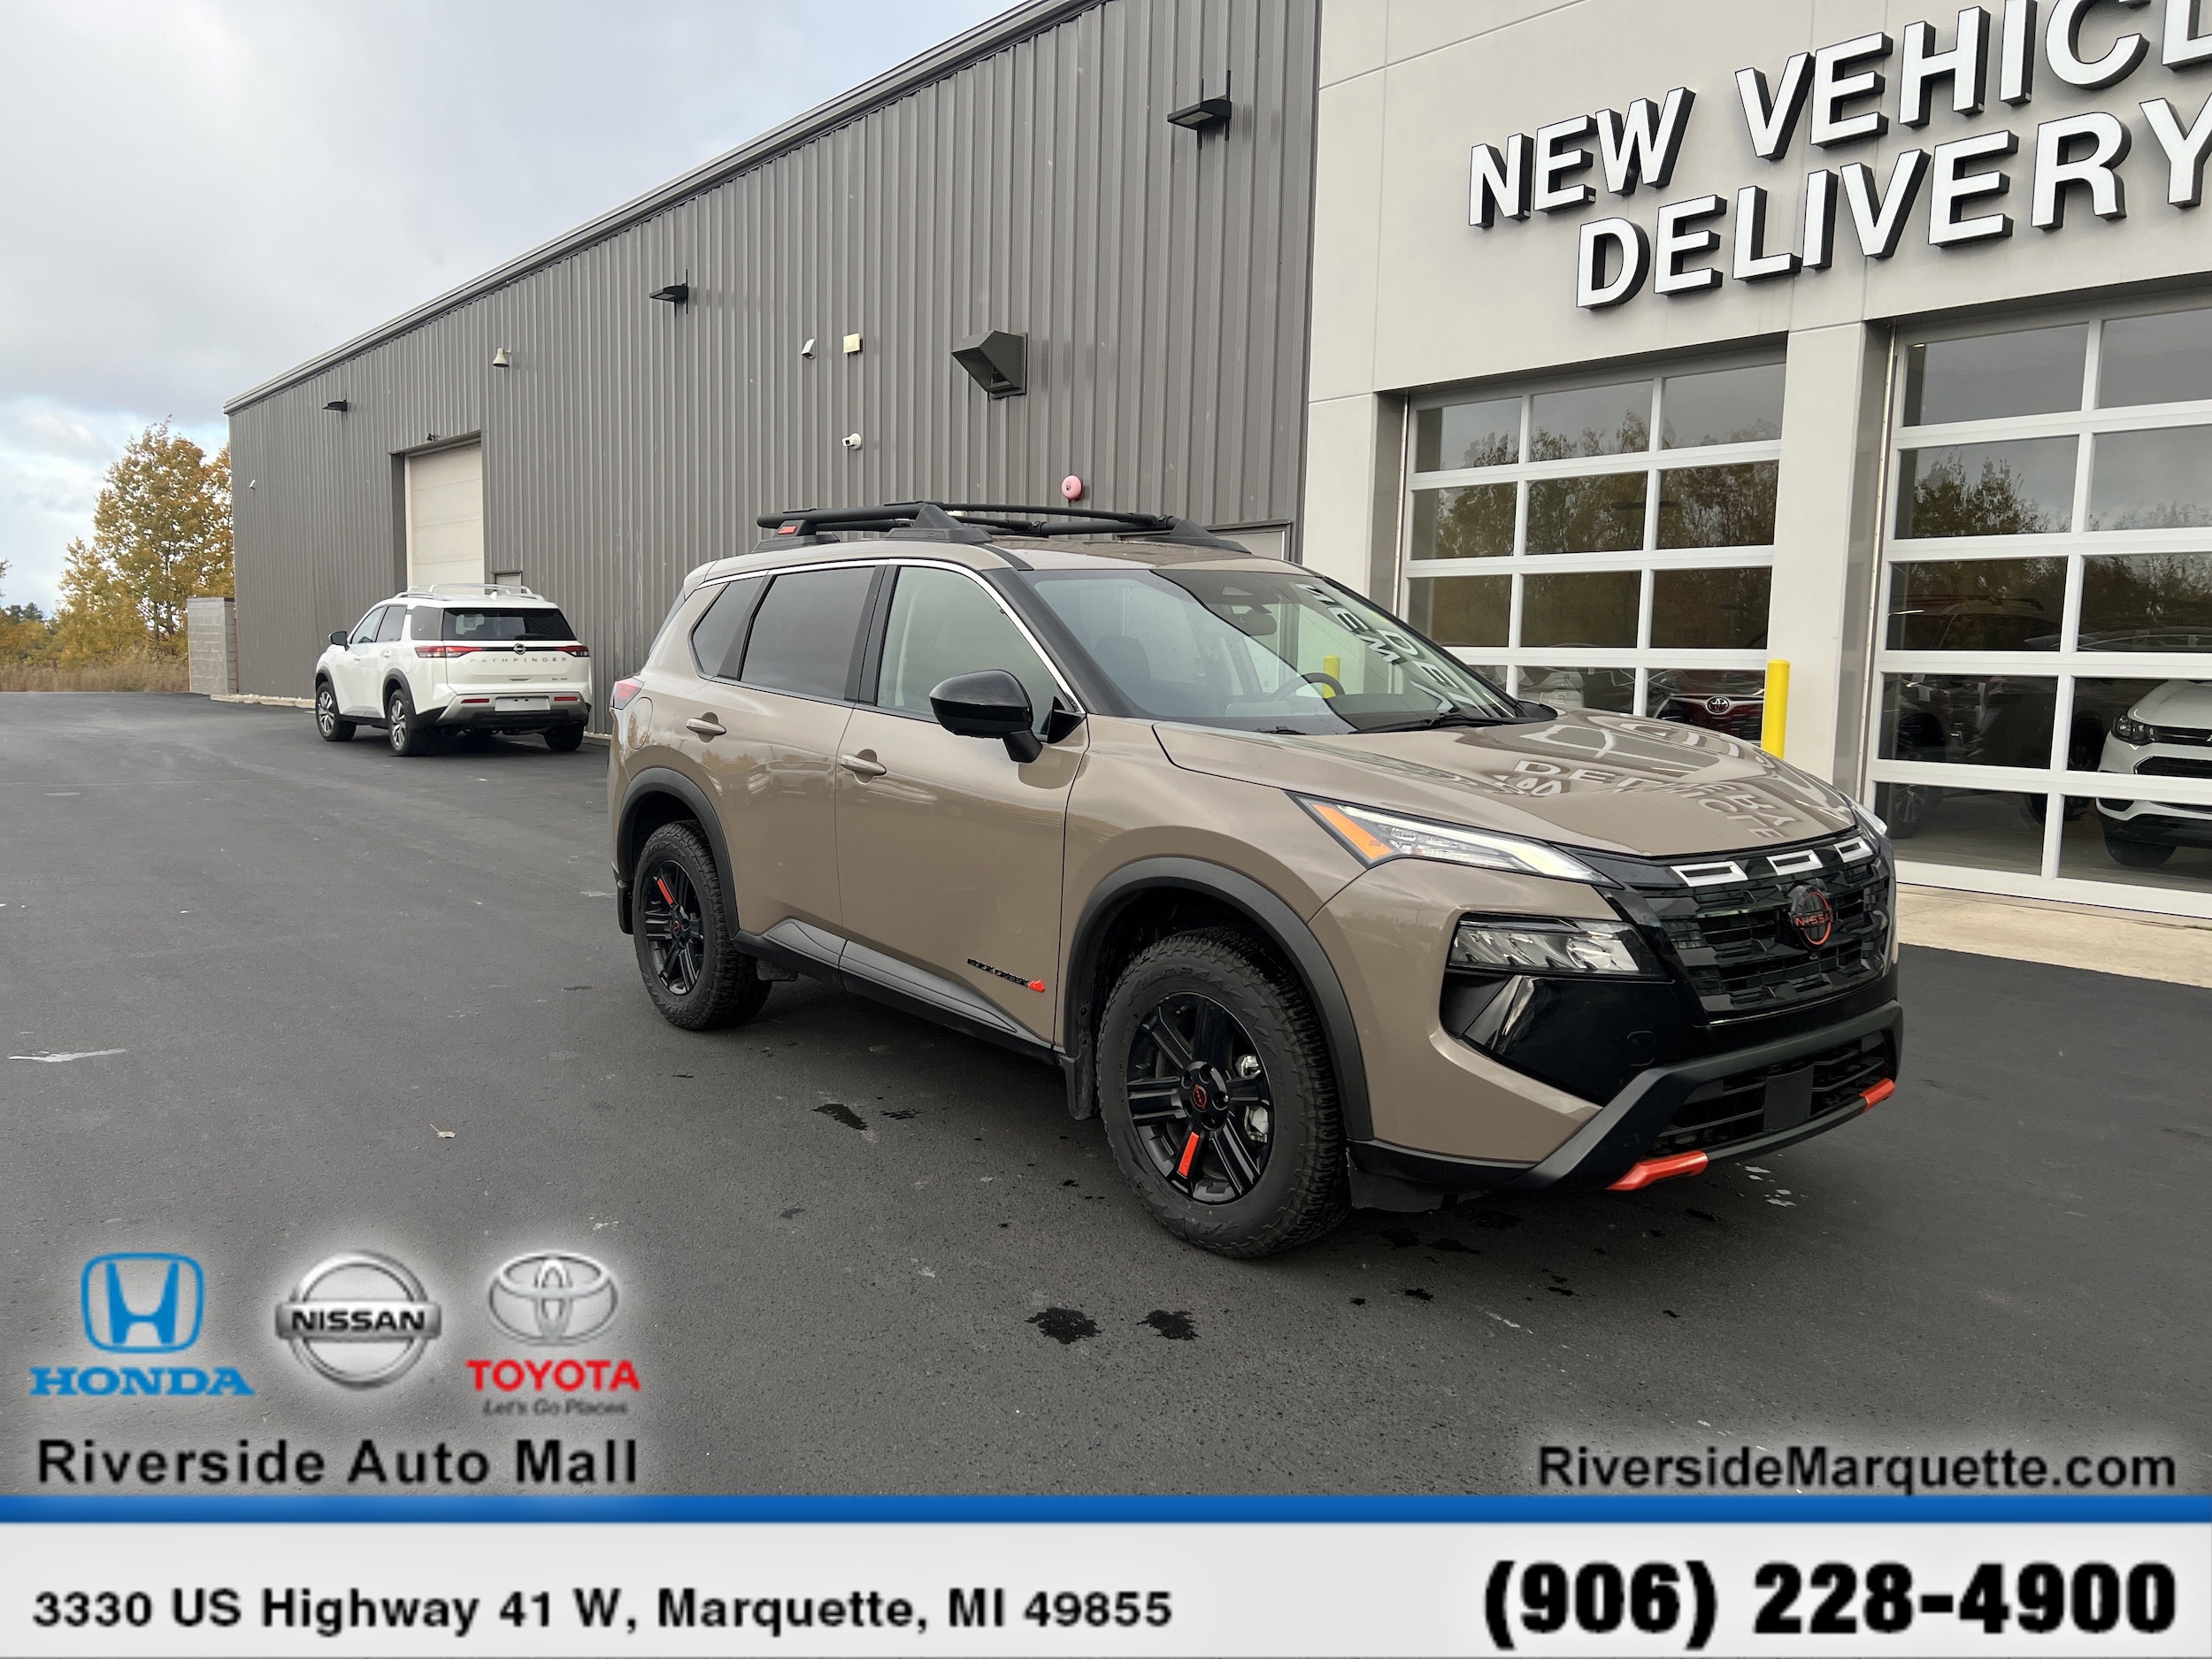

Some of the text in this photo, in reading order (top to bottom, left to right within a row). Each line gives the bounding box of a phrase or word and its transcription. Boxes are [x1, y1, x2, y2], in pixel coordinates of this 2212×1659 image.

[1468, 87, 1695, 227] NEW
[1576, 92, 2212, 310] DELIVERY
[1794, 913, 1832, 927] NISSA
